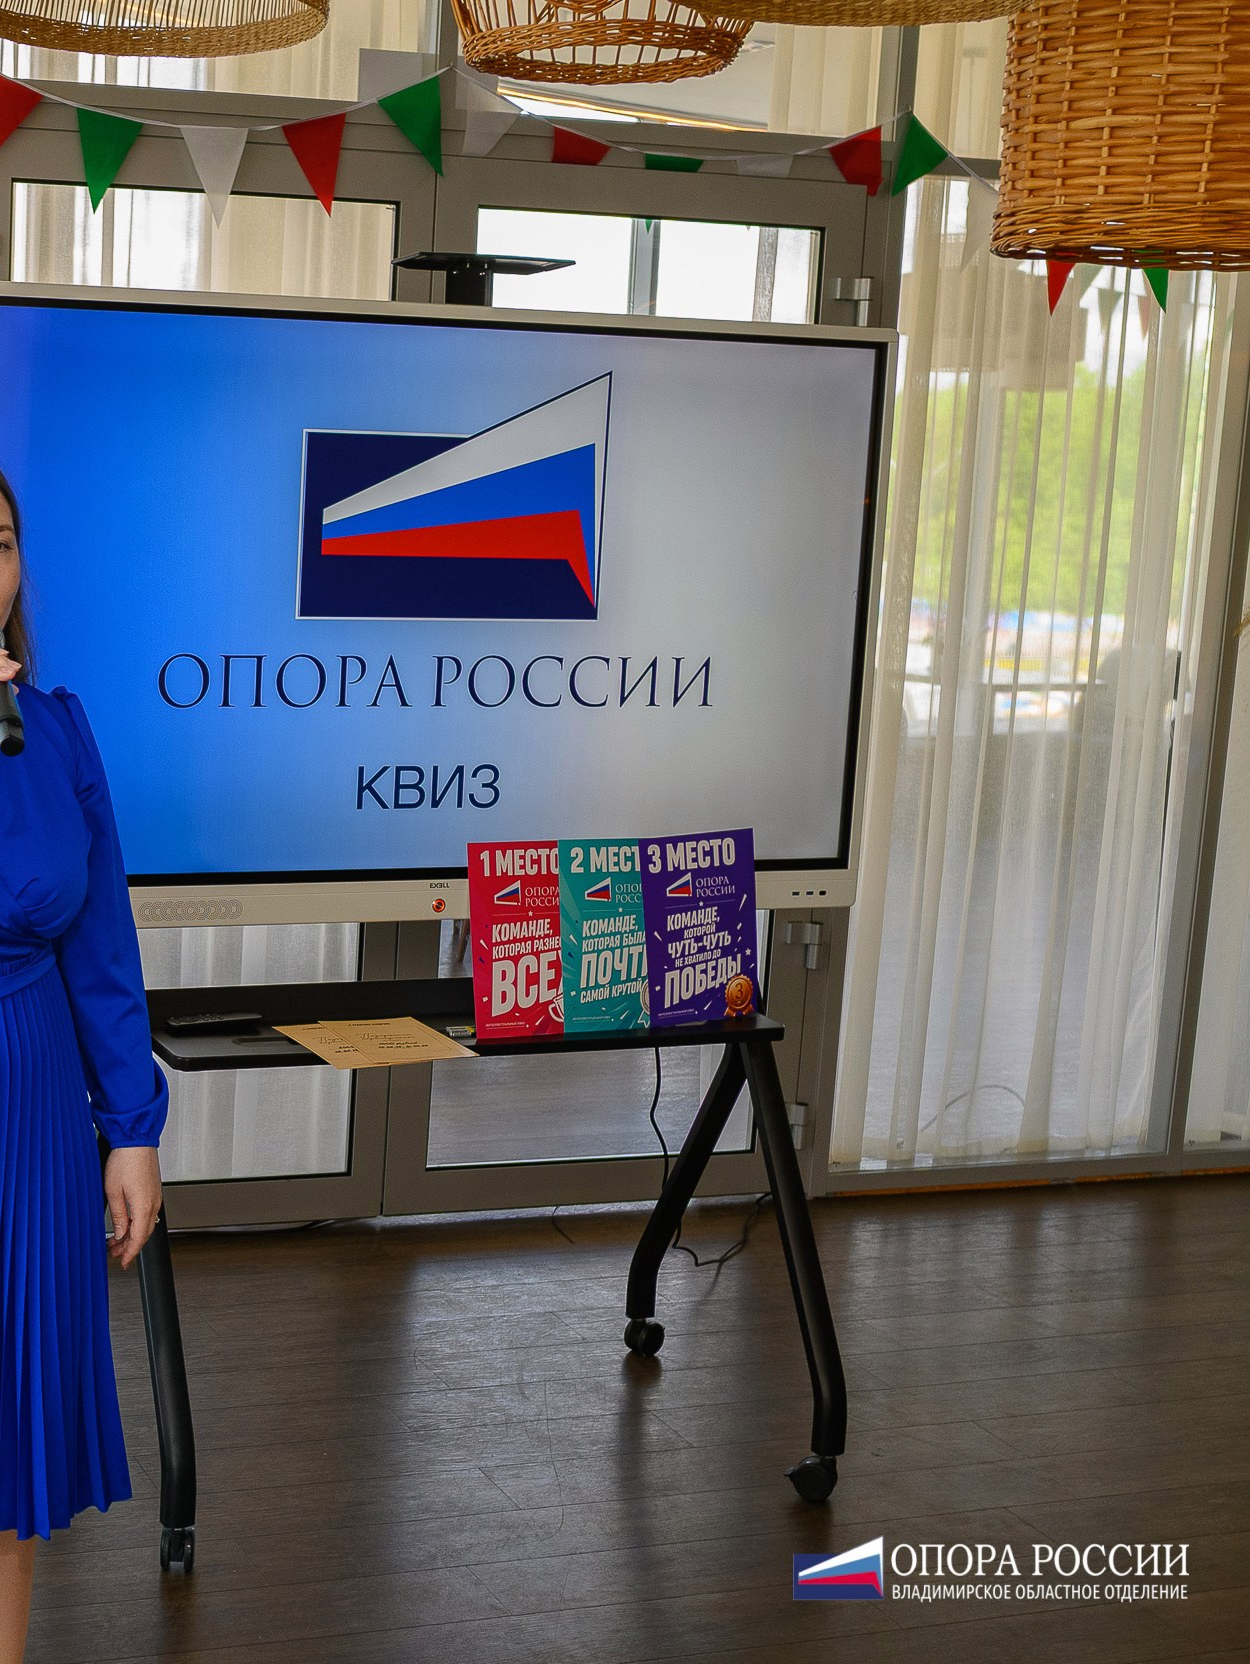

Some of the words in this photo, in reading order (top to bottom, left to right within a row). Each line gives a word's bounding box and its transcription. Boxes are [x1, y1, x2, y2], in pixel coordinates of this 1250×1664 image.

[157, 652, 413, 709] ОПОРА
[431, 655, 714, 709] РОССИИ
[356, 763, 501, 810] КВИЗ
[480, 850, 490, 877] 1
[495, 848, 559, 877] МЕСТО
[570, 847, 584, 874] 2
[590, 845, 641, 873] МЕСТ
[647, 844, 662, 874] 3
[666, 837, 736, 872] МЕСТО
[615, 883, 642, 893] ОПО
[696, 876, 730, 888] ОПОРА
[696, 885, 736, 898] РОССИИ
[525, 896, 560, 908] РОССИ
[615, 893, 642, 904] РОСС
[582, 915, 639, 937] КОМАНДЕ,
[667, 906, 720, 931] КОМАНДЕ,
[491, 918, 553, 943] КОМАНДЕ,
[683, 923, 716, 939] КОТОРОЙ
[492, 941, 532, 960] КОТОРАЯ
[582, 935, 621, 952] КОТОРАЯ
[667, 930, 732, 958] ЧУТЬ-ЧУТЬ
[675, 958, 684, 968] НЕ
[684, 951, 711, 966] ХВАТИЛО
[712, 949, 722, 961] ДО
[491, 950, 563, 1018] ВСЕ
[580, 984, 610, 1003] САМОЙ
[611, 978, 642, 998] КРУТОЙ
[664, 953, 741, 1009] ПОБЕДЫ
[735, 982, 744, 999] 3
